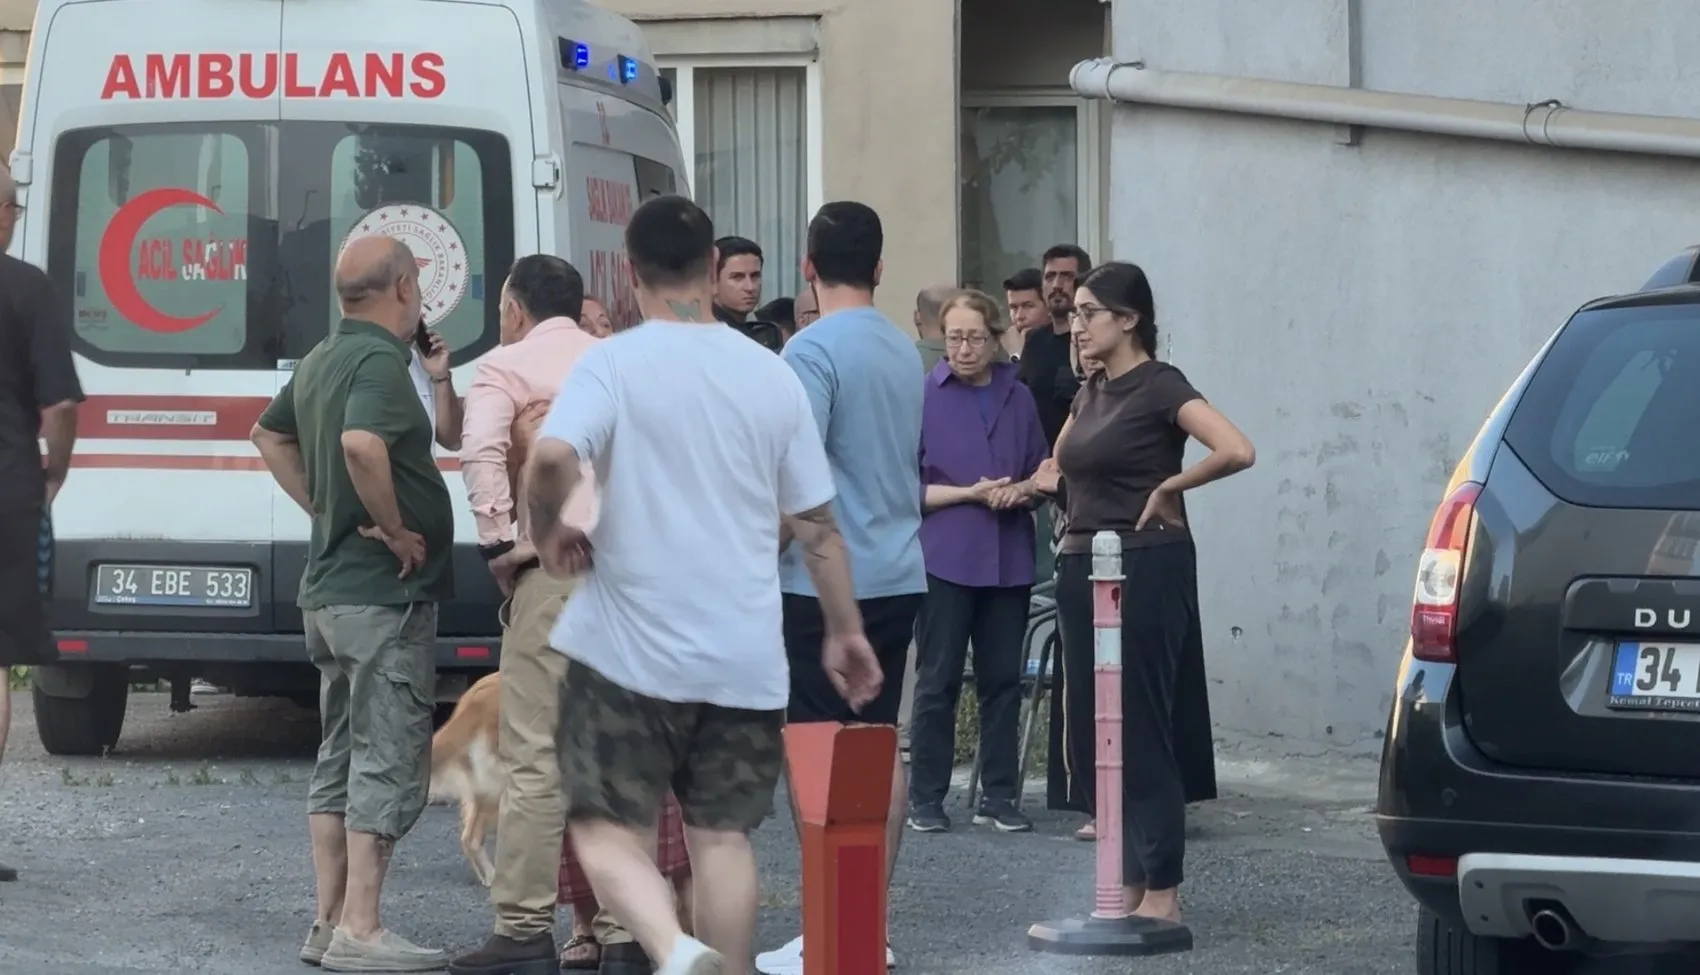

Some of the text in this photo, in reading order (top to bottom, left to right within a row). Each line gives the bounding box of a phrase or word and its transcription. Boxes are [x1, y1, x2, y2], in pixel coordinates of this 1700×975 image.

[100, 52, 446, 99] AMBULANS
[111, 568, 247, 598] 34 EBE 533
[1617, 672, 1633, 686] TR
[1636, 646, 1681, 692] 34
